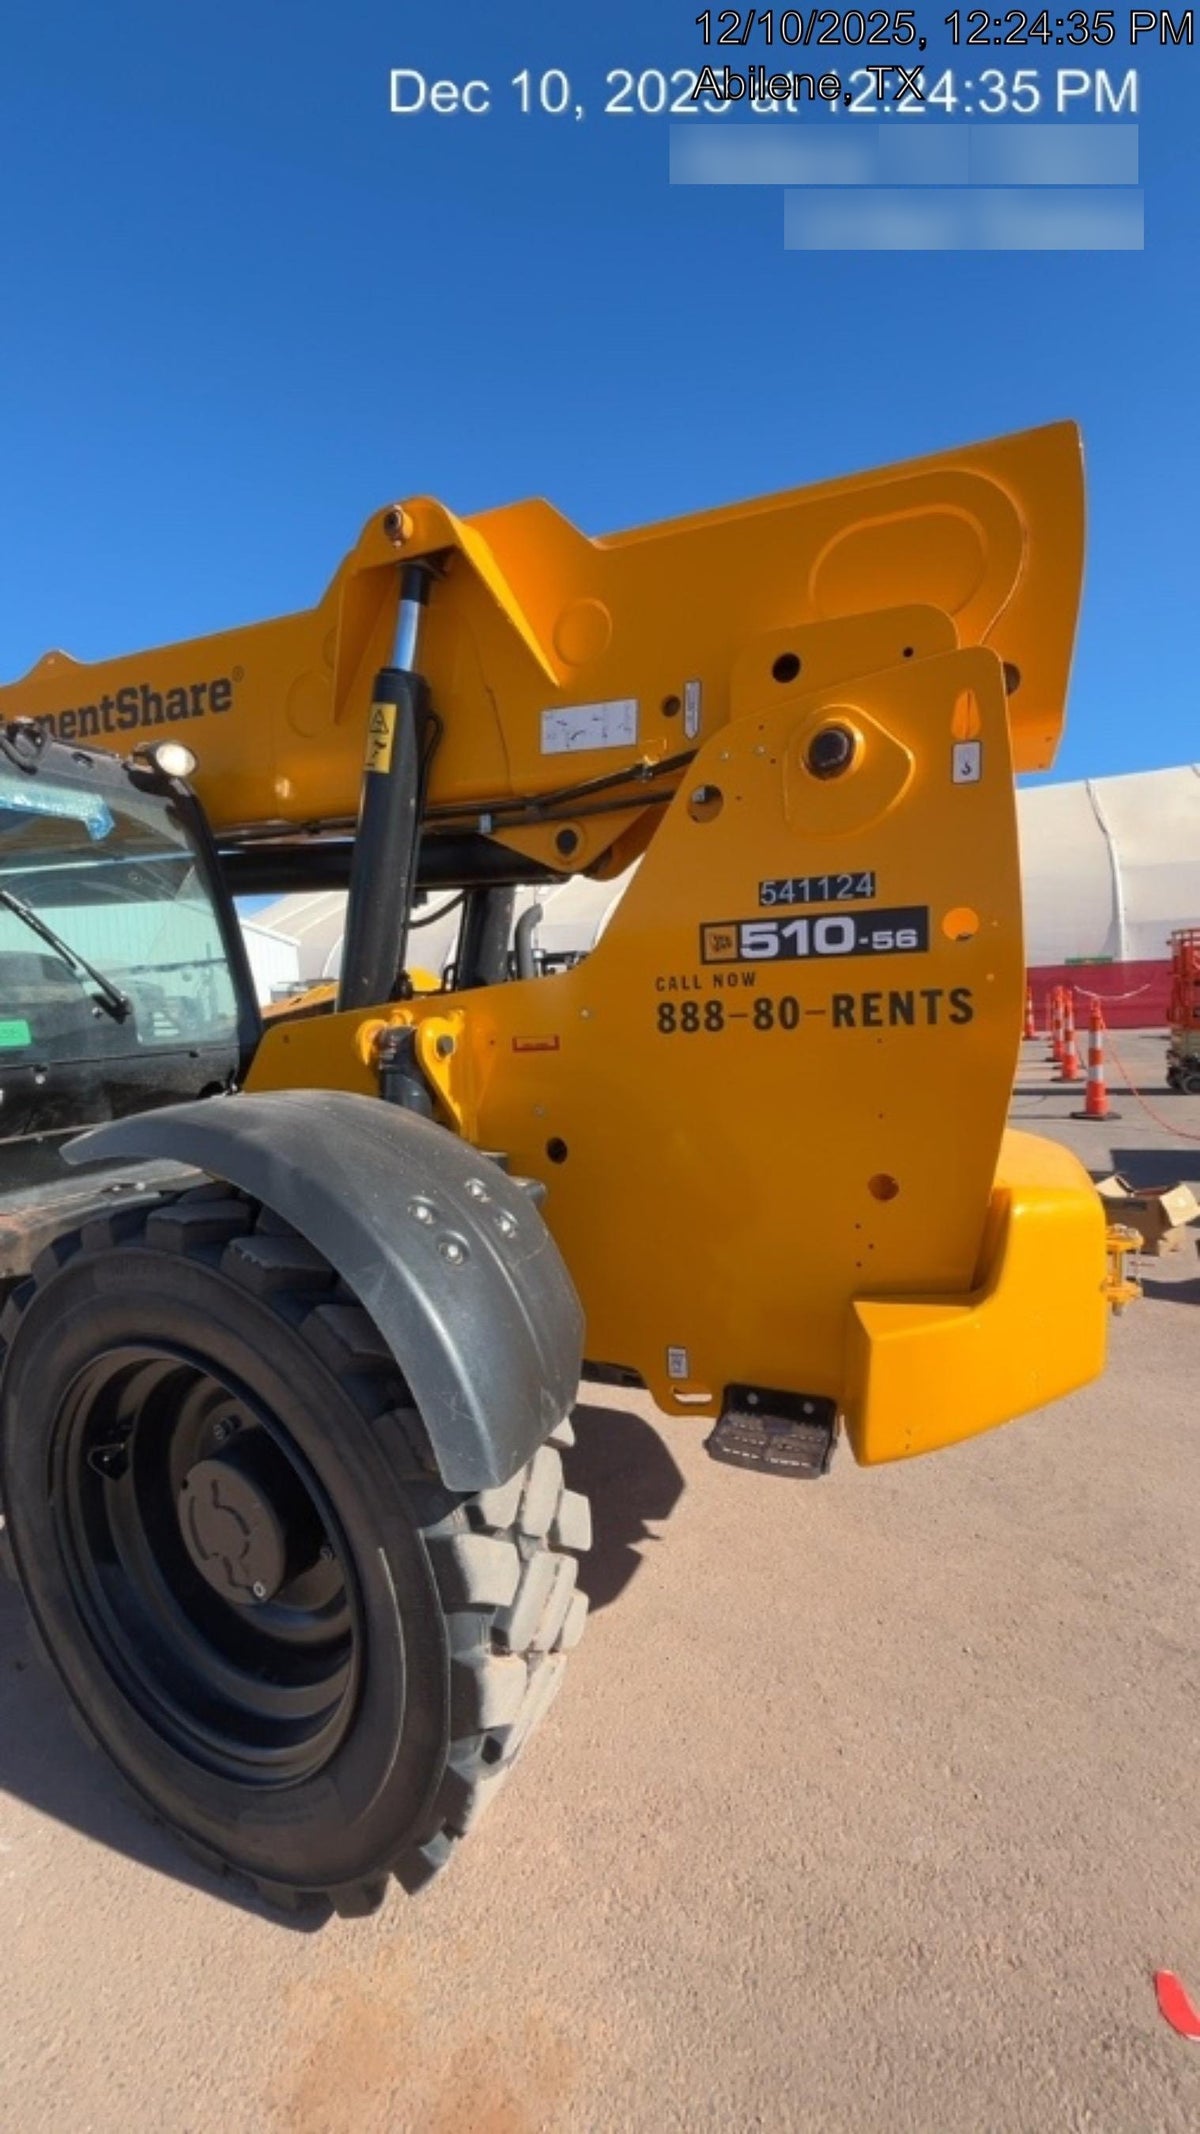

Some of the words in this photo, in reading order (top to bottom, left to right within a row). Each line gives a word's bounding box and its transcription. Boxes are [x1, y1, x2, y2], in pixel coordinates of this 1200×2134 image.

[760, 872, 873, 905] 541124
[741, 916, 918, 959] 510-56
[655, 976, 702, 992] CALL
[713, 972, 756, 989] NOW
